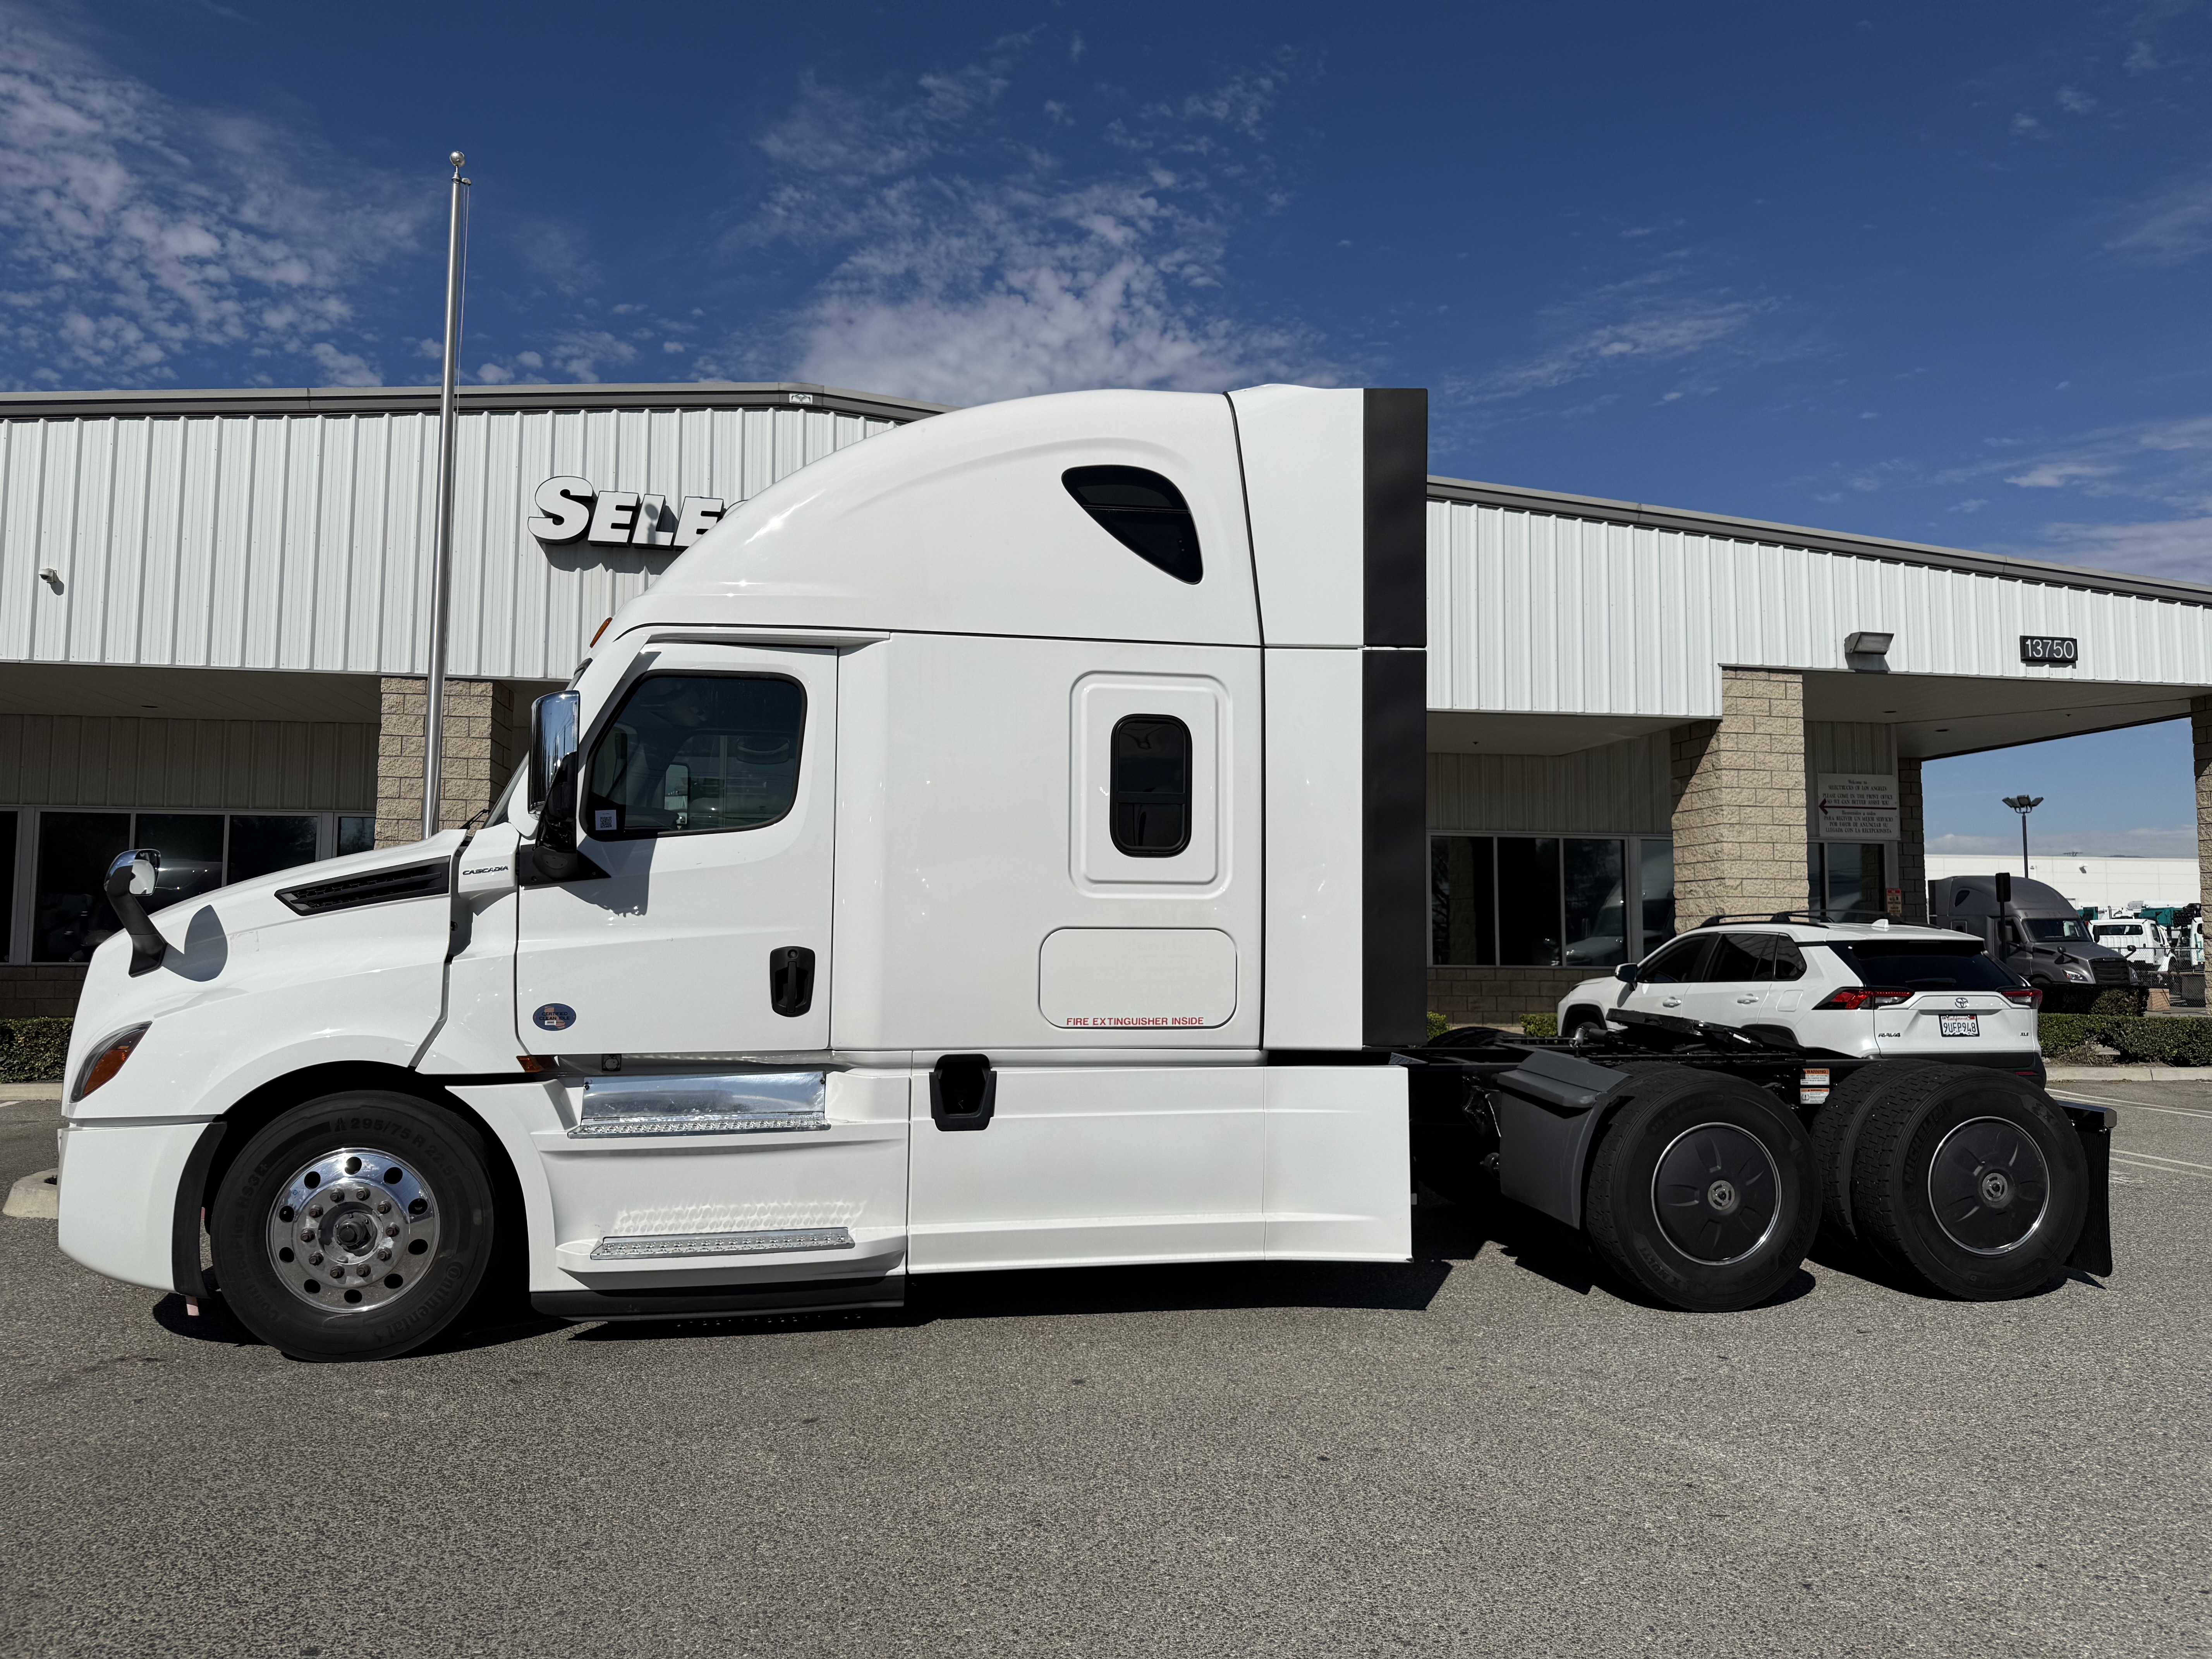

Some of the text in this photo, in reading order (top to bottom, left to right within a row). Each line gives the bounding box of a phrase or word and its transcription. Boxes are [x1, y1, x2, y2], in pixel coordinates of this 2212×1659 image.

[2025, 639, 2075, 659] 13750
[462, 866, 509, 876] CASCADIA
[1066, 1017, 1204, 1025] FIRE EXTINGUISHER INSIDE
[350, 1118, 411, 1140] 295/75
[412, 1134, 426, 1148] R
